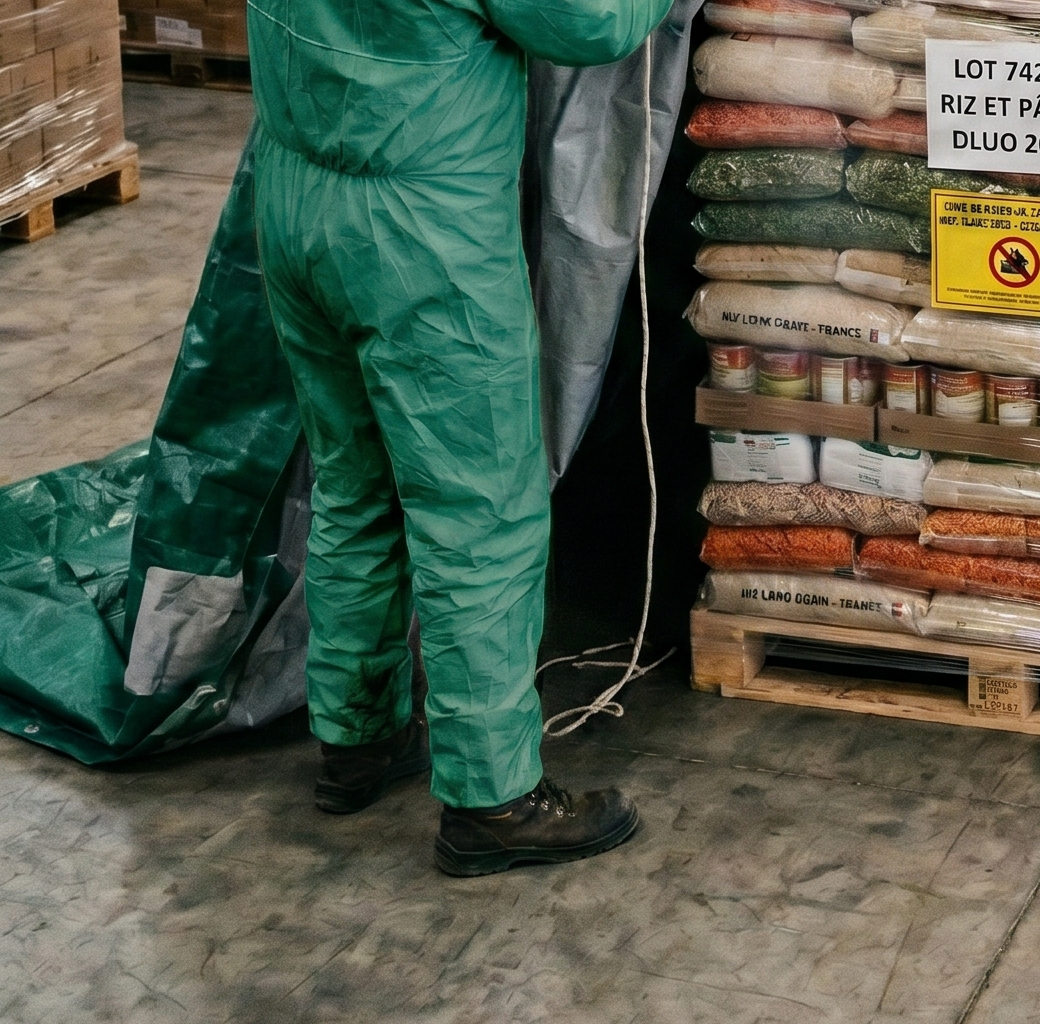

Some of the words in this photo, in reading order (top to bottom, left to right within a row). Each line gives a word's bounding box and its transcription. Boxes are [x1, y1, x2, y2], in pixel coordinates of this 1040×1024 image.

[954, 58, 998, 80] LOT
[941, 94, 977, 115] RIZ
[985, 96, 1011, 117] ET
[952, 130, 1018, 153] DLUO
